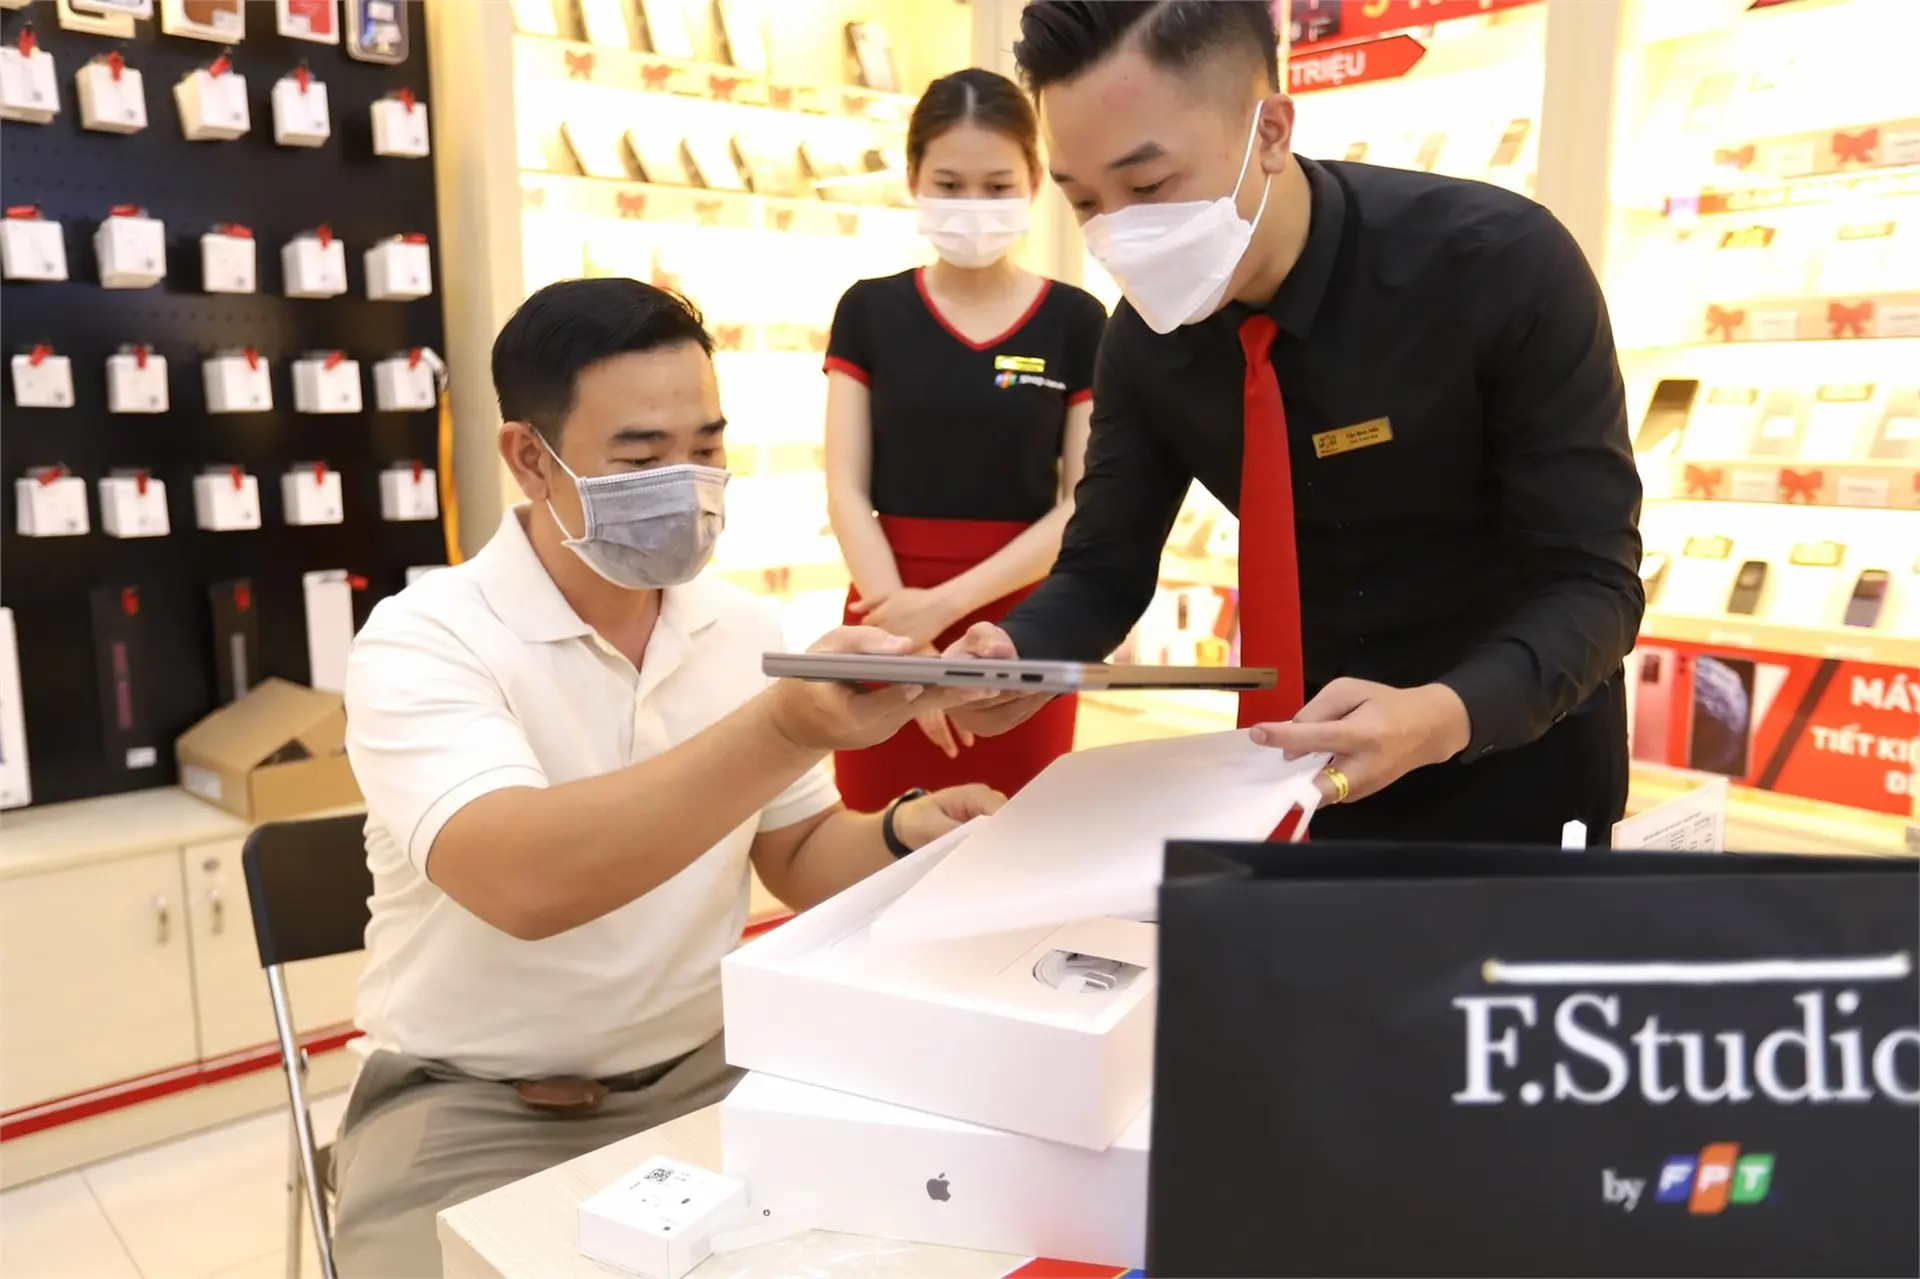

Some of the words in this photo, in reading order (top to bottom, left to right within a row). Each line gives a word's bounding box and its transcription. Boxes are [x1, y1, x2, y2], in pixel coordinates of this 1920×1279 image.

[1289, 50, 1366, 86] TRIỆU
[1451, 990, 1920, 1104] F.Studio
[1602, 1167, 1646, 1213] by
[1658, 1163, 1768, 1194] FPT
